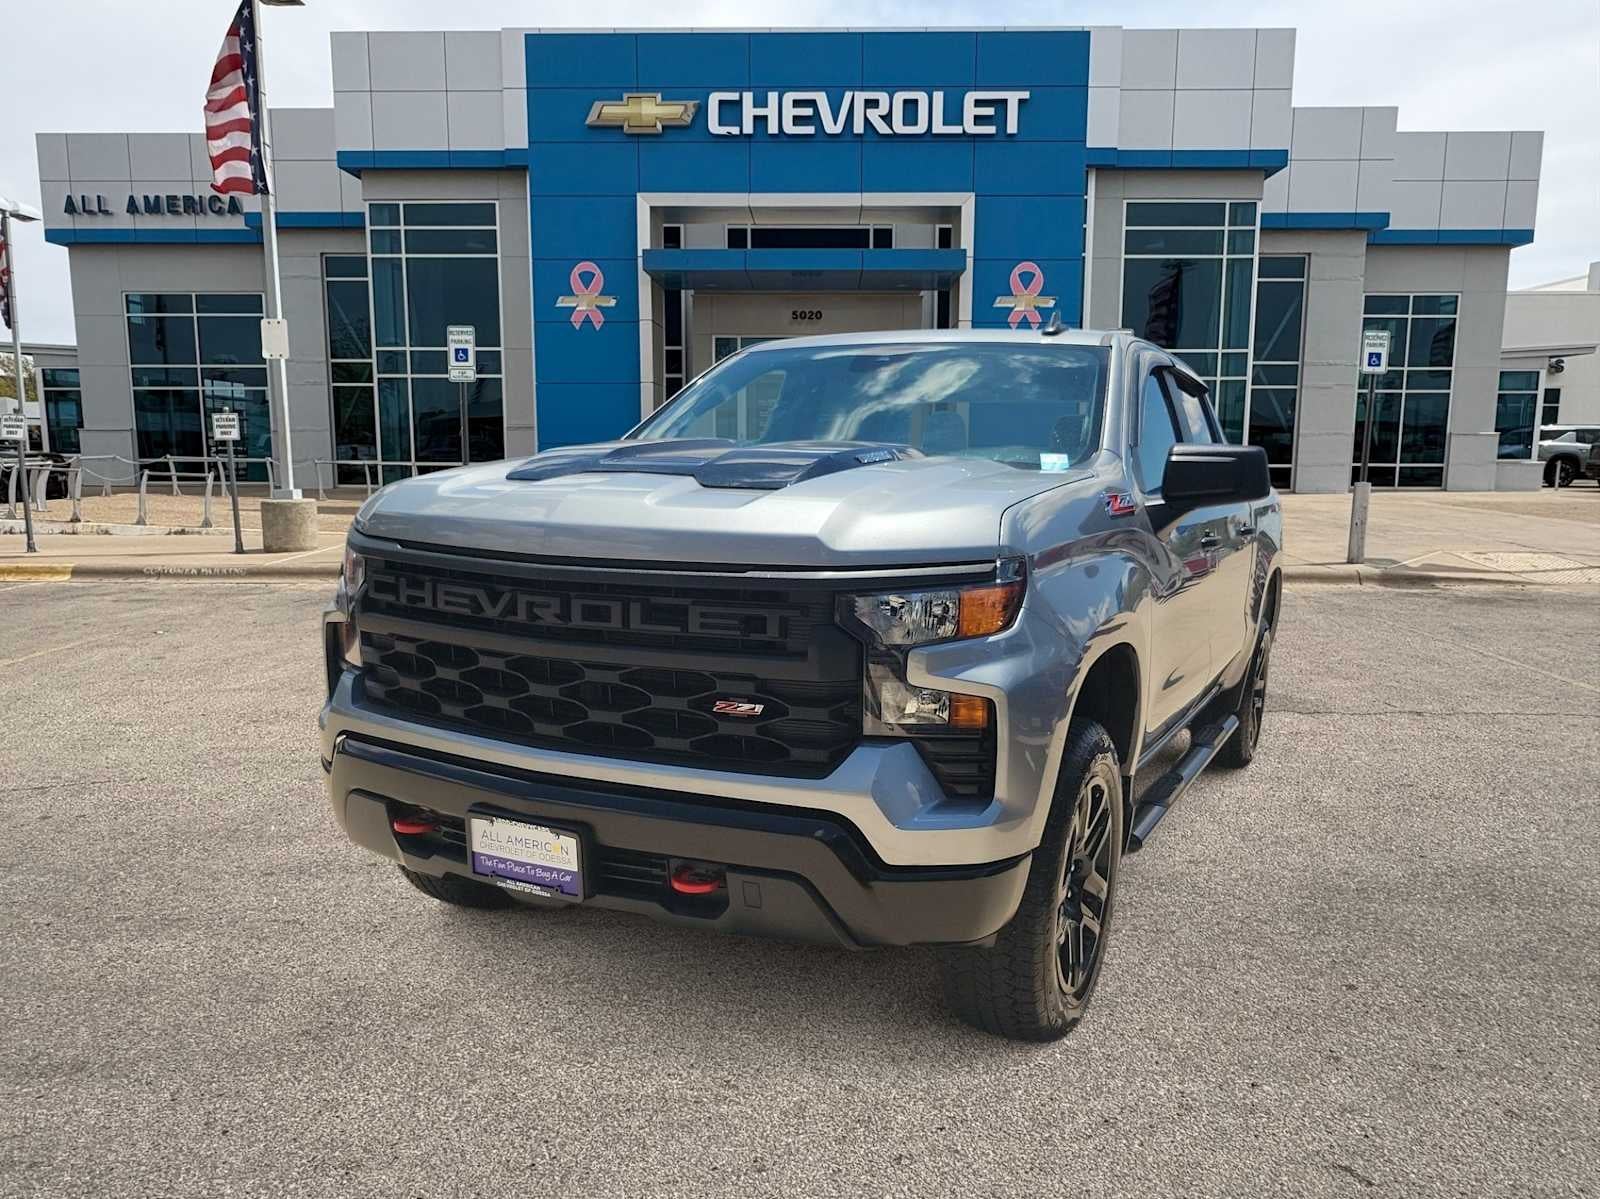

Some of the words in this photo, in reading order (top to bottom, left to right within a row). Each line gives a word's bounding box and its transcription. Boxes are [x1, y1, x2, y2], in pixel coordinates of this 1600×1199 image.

[708, 91, 1030, 135] CHEVROLET
[64, 194, 112, 215] ALL
[791, 310, 823, 320] 5020
[367, 575, 792, 639] CHEVROLET
[712, 700, 764, 716] Z71
[481, 829, 503, 843] ALL
[480, 841, 524, 856] CHEVROLET
[526, 849, 536, 858] OF
[539, 852, 572, 865] ODESSA
[480, 855, 493, 866] The
[506, 861, 525, 873] Place
[525, 865, 535, 875] To
[536, 869, 551, 882] Buy
[551, 871, 558, 880] A
[560, 872, 572, 882] Car
